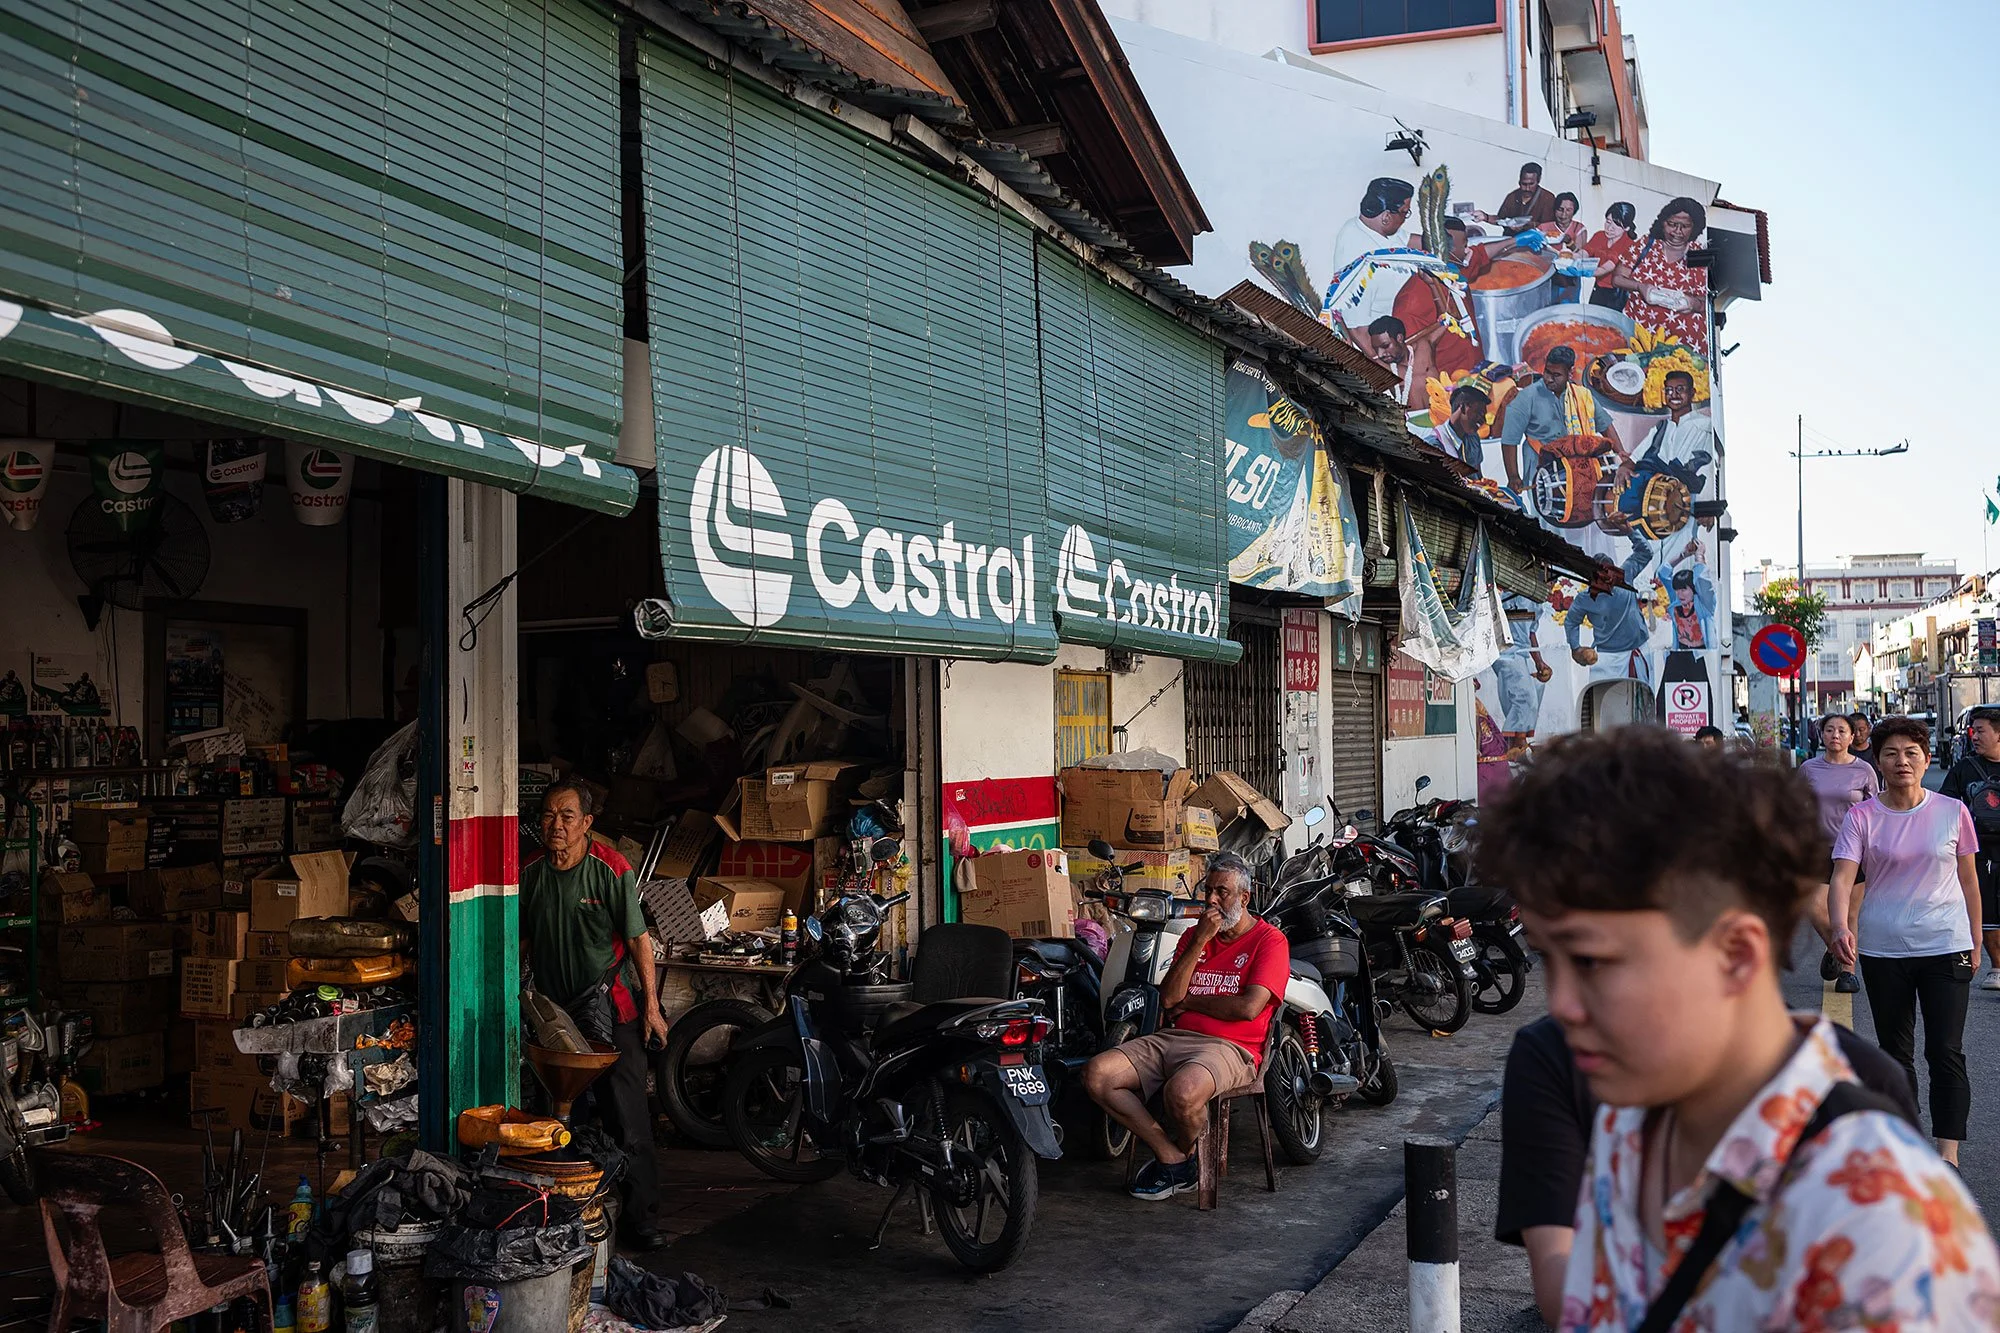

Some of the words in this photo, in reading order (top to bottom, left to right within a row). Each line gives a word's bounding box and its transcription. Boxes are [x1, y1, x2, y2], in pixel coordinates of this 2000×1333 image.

[224, 461, 259, 477] Castrol
[291, 493, 349, 507] Castrol
[1227, 512, 1262, 534] UBRICANTS
[806, 497, 1037, 625] Castrol
[1106, 558, 1221, 638] Castrol
[1287, 628, 1303, 652] KUAN
[1306, 631, 1317, 653] YEE
[1006, 1067, 1037, 1082] PNK
[1007, 1081, 1046, 1097] 7689
